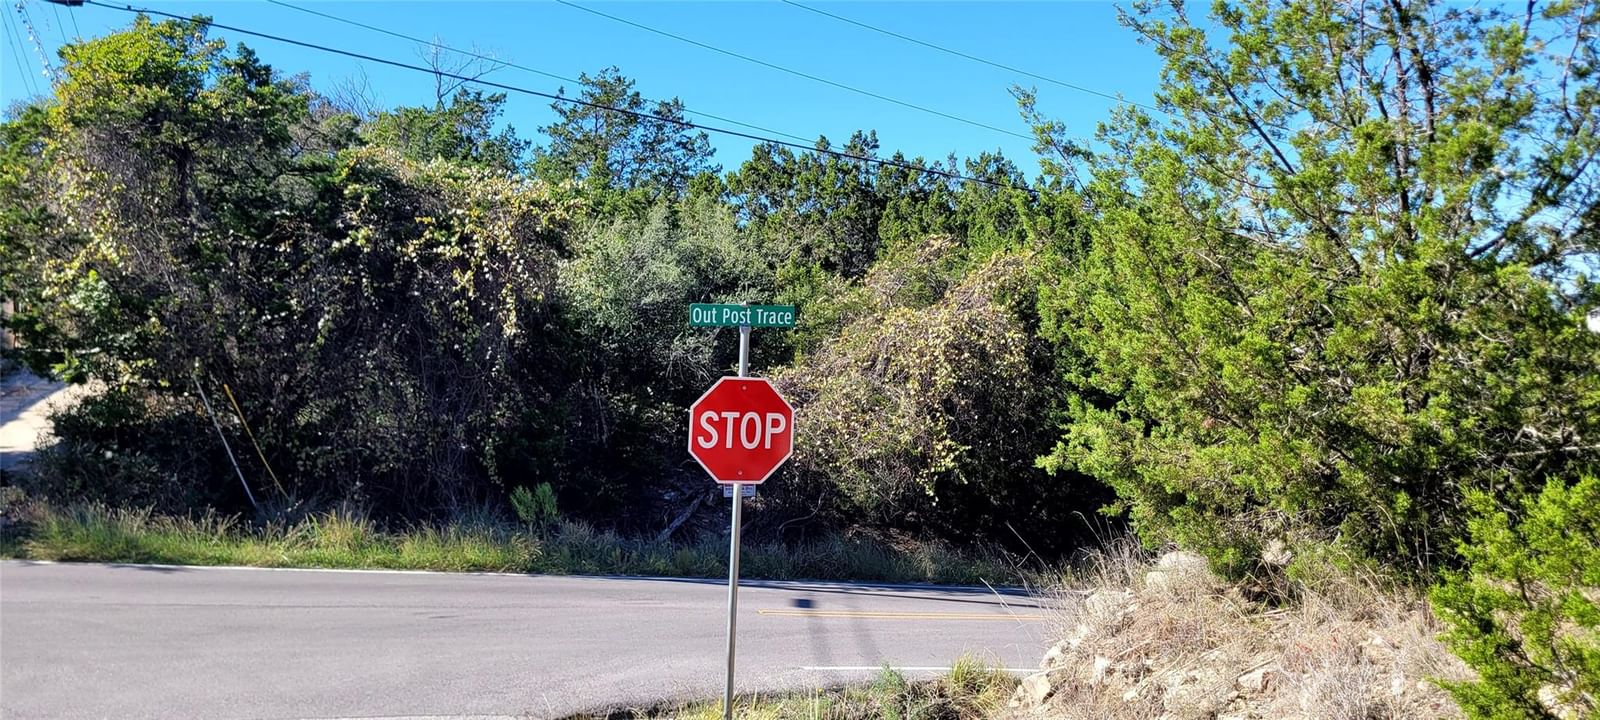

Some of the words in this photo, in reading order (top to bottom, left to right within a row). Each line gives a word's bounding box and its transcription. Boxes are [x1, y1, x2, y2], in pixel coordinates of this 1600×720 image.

[692, 307, 717, 324] Out
[722, 307, 752, 324] Post
[756, 308, 792, 325] Trace
[697, 410, 786, 449] STOP
